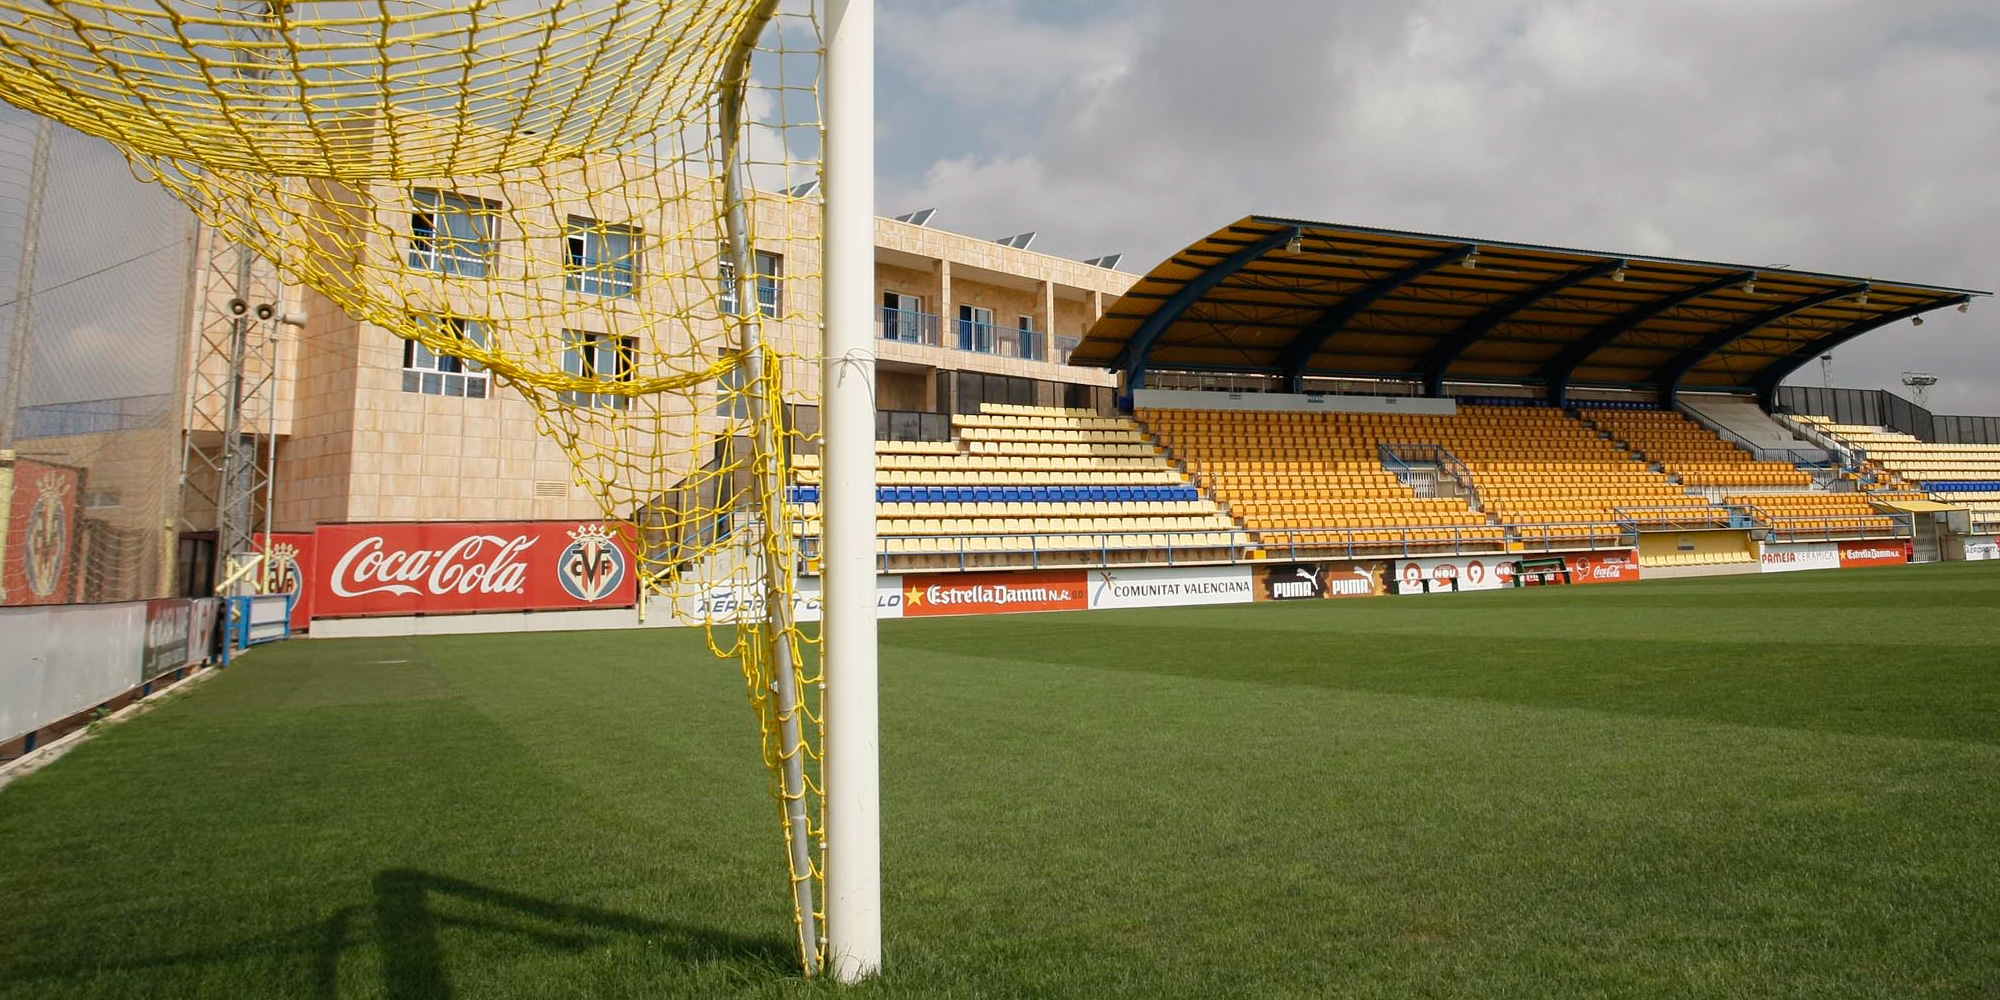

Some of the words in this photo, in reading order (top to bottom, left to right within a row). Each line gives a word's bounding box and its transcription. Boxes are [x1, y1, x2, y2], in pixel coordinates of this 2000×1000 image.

[330, 535, 540, 597] Coca-Cola
[1762, 553, 1796, 564] PAMESA
[1114, 584, 1181, 598] COMUNITAT
[1184, 581, 1251, 595] VALENCIANA
